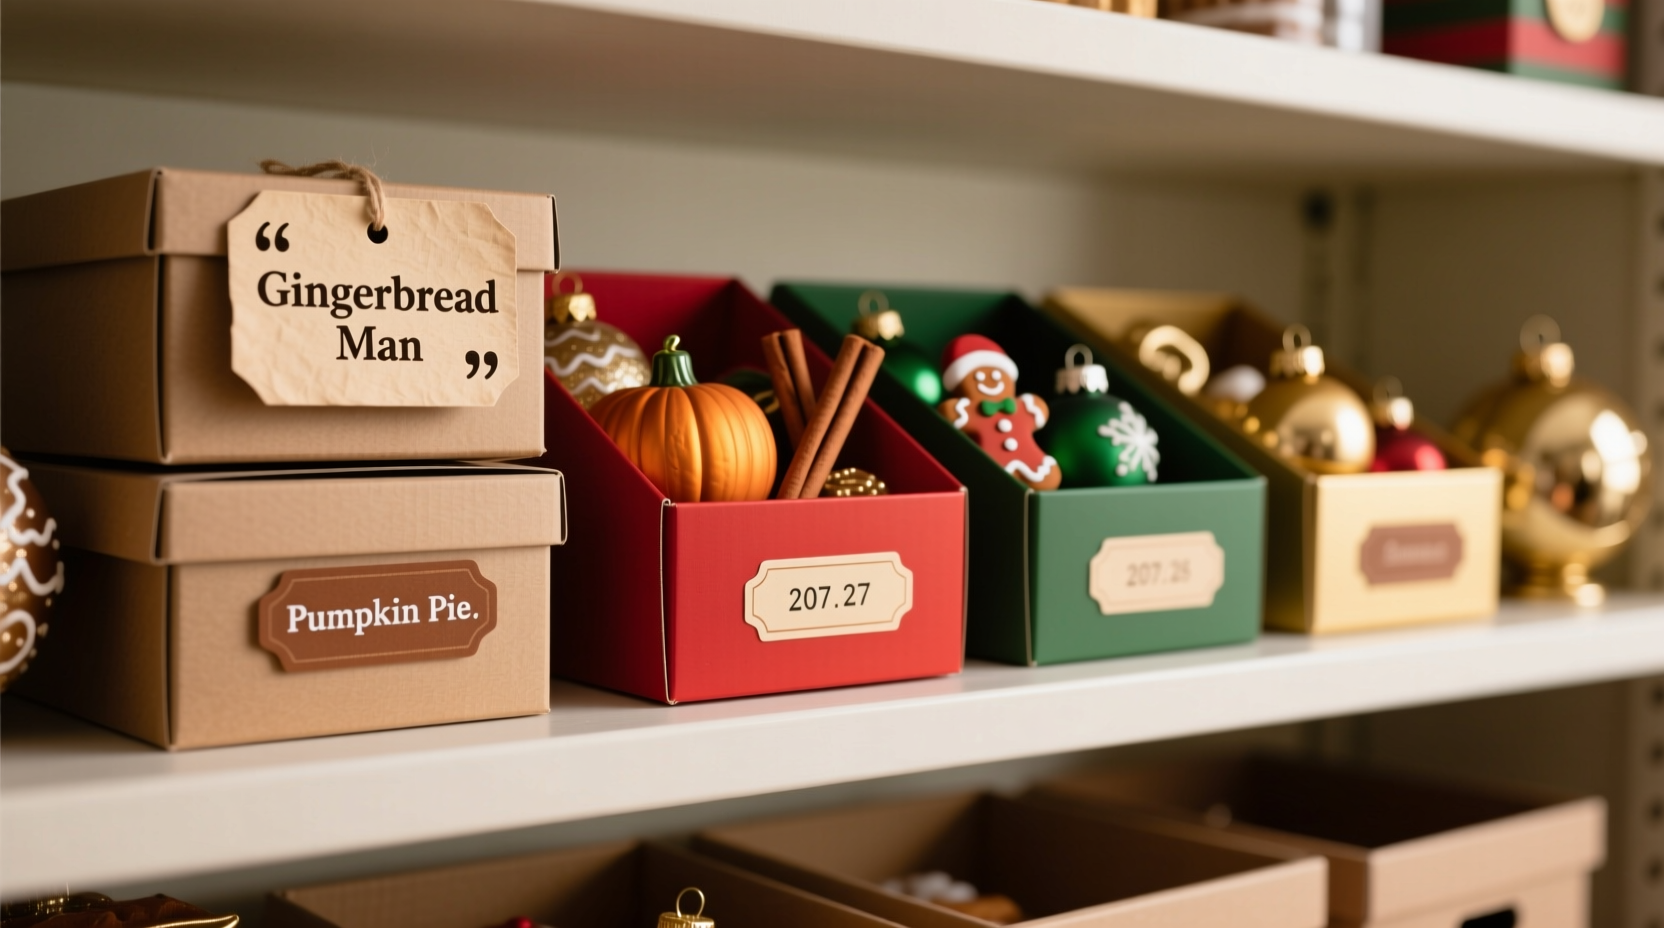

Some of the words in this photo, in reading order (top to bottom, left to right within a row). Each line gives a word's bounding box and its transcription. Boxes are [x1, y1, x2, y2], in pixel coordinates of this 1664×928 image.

[257, 270, 499, 320] Gingerbread
[335, 325, 424, 362] Man
[286, 597, 421, 637] Pumpkin
[428, 593, 480, 624] Pie.
[789, 582, 872, 612] 207.27
